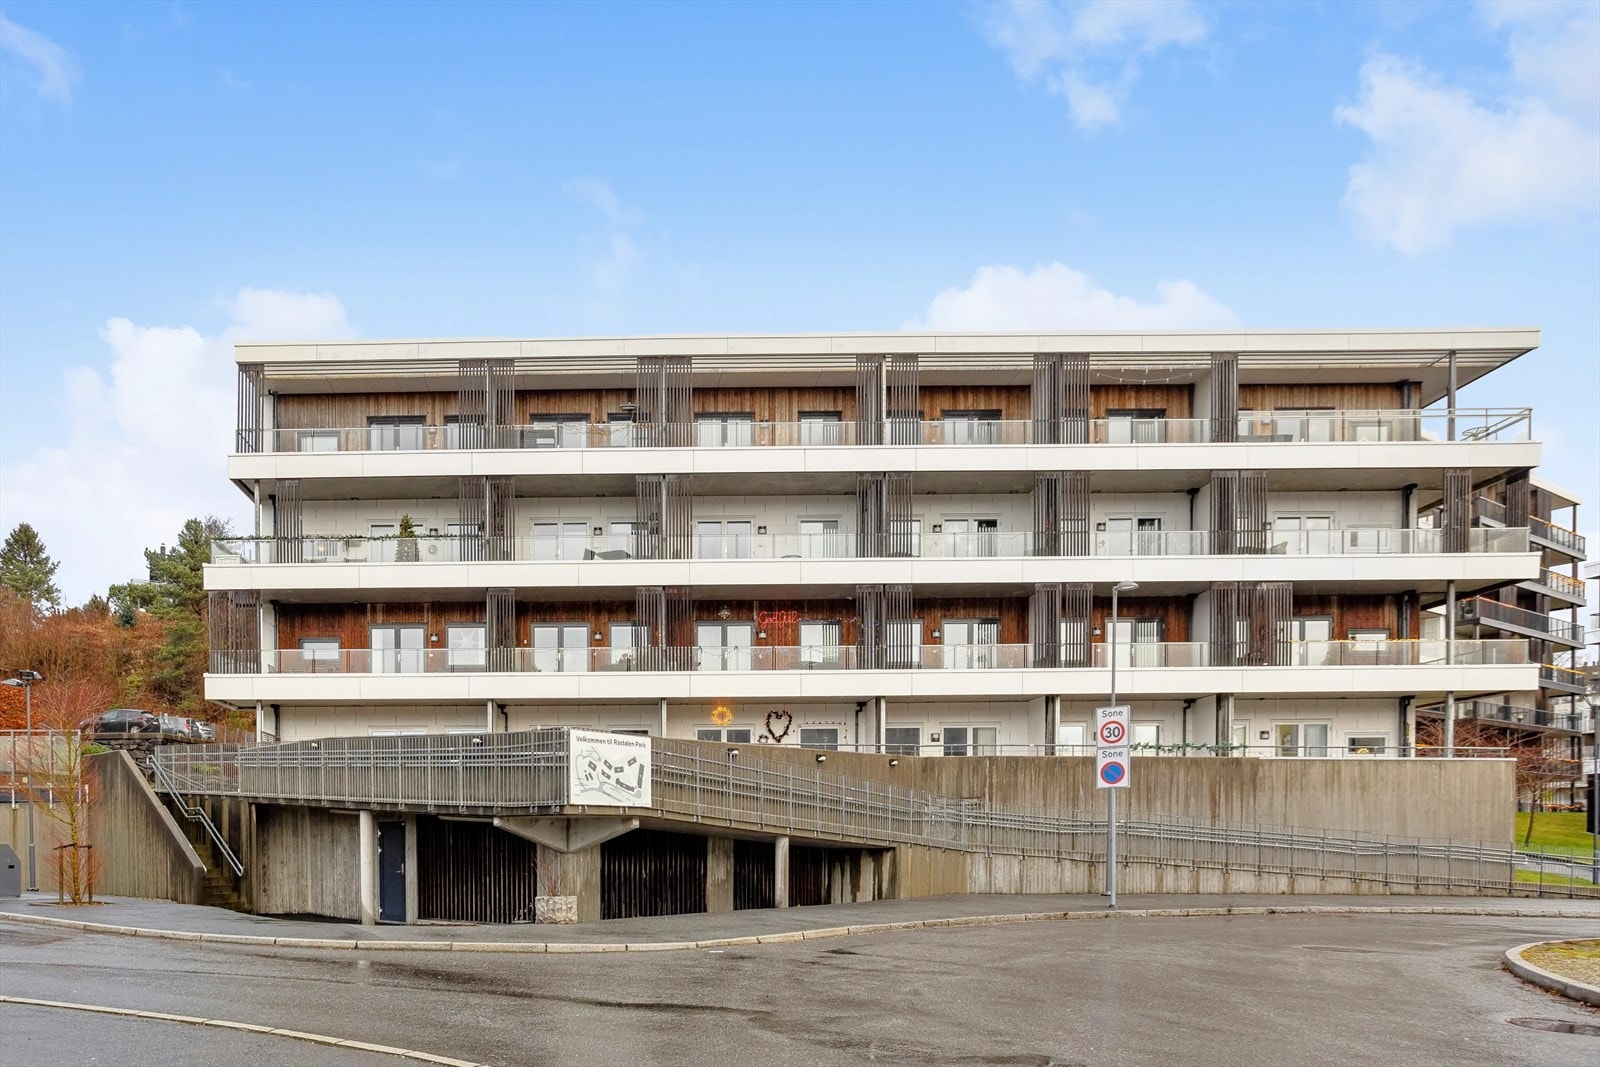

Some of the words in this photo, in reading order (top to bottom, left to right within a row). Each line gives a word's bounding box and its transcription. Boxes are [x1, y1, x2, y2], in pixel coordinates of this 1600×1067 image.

[1102, 710, 1123, 718] Sone
[1105, 726, 1121, 739] 30
[576, 736, 606, 744] Velkommen
[1102, 750, 1123, 759] Sone
